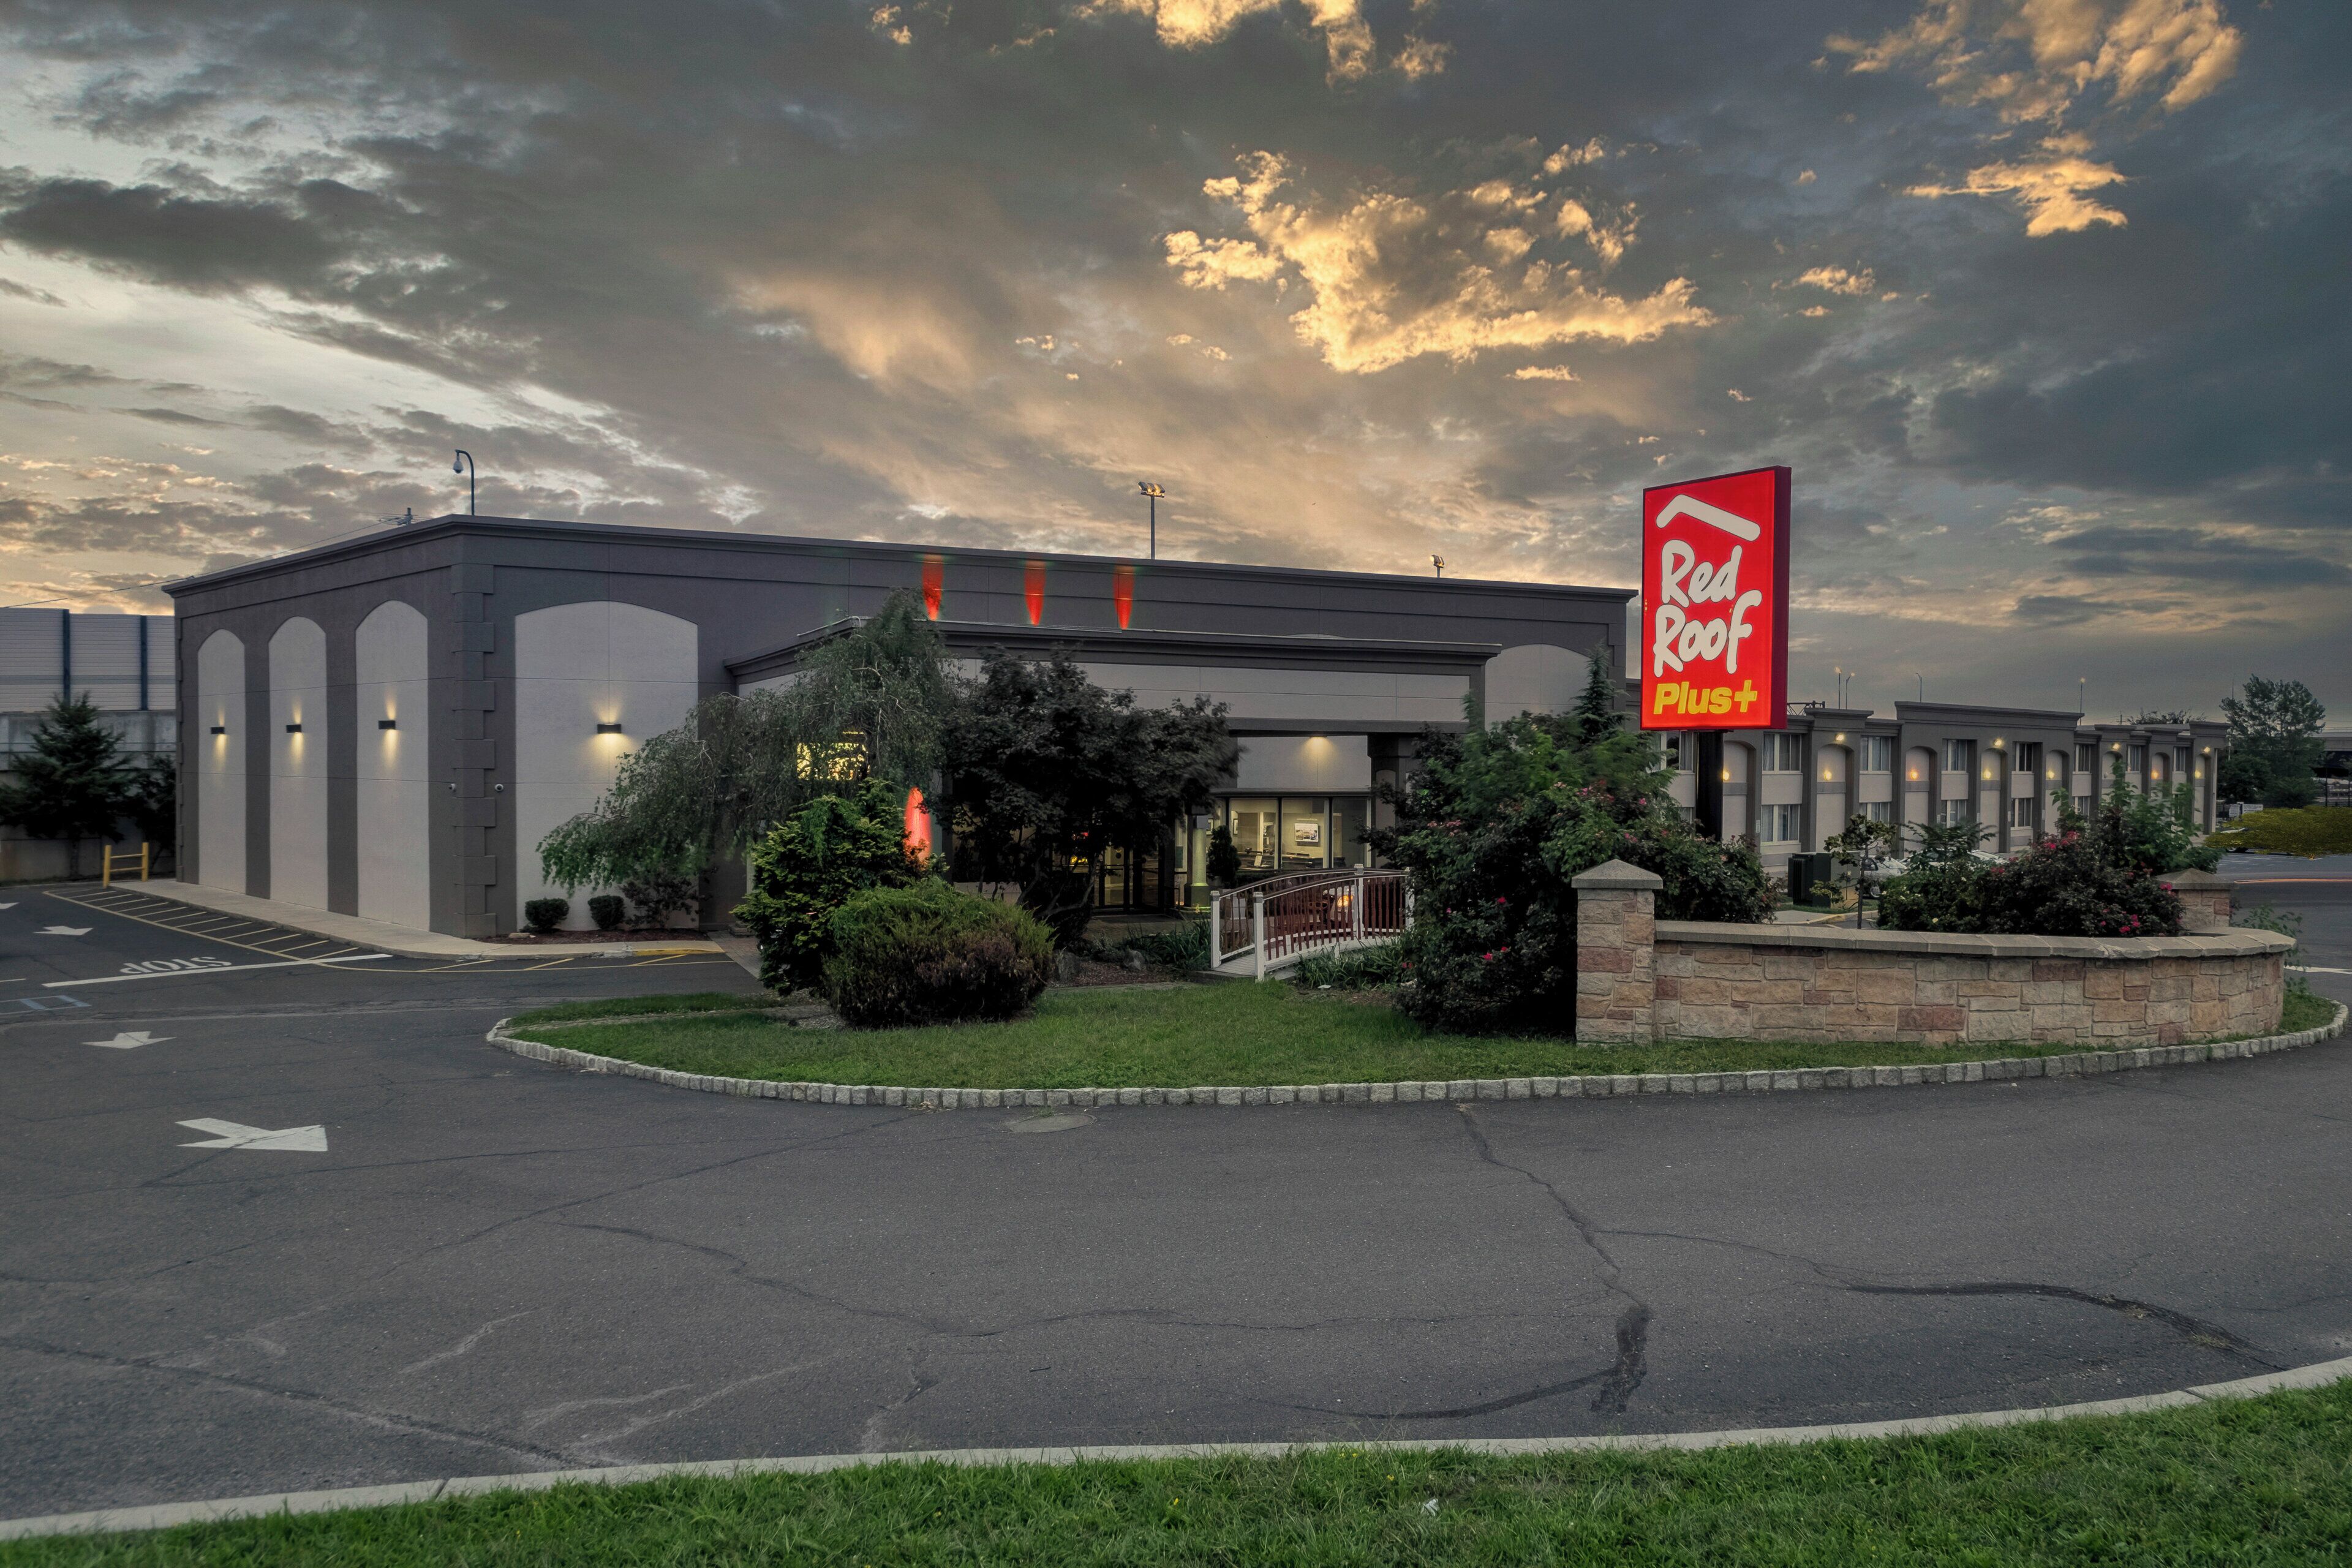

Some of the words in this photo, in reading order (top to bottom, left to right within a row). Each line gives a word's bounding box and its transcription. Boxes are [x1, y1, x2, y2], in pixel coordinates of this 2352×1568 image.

[1661, 539, 1743, 608] Red
[1653, 589, 1762, 677] Roof
[1653, 679, 1758, 715] Plus+
[119, 957, 232, 974] STOP
